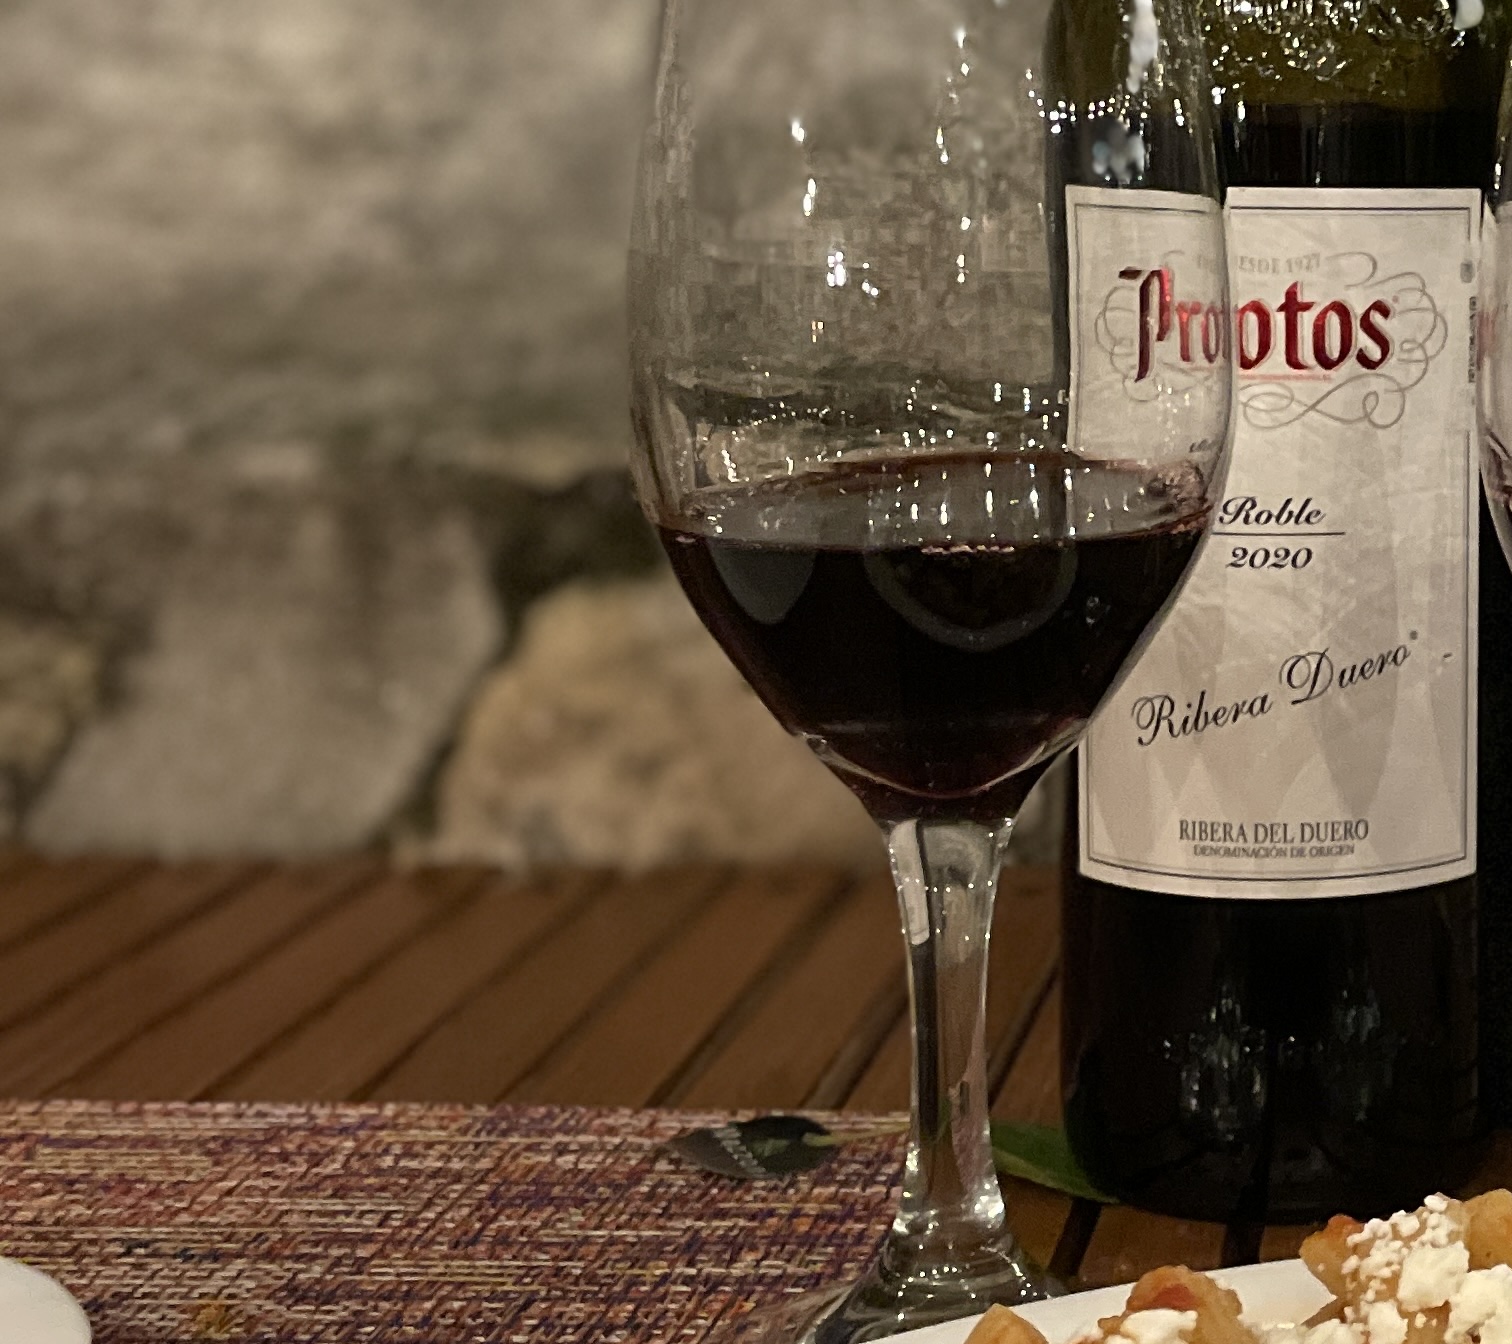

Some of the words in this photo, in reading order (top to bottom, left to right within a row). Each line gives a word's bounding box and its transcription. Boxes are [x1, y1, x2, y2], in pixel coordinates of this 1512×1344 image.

[1218, 495, 1326, 527] Roble
[1226, 546, 1314, 570] 2020
[1131, 690, 1273, 747] Ribera
[1179, 819, 1248, 844] RIBERA
[1253, 821, 1295, 845] DEL
[1300, 819, 1369, 843] DUERO
[1290, 846, 1307, 859] DE
